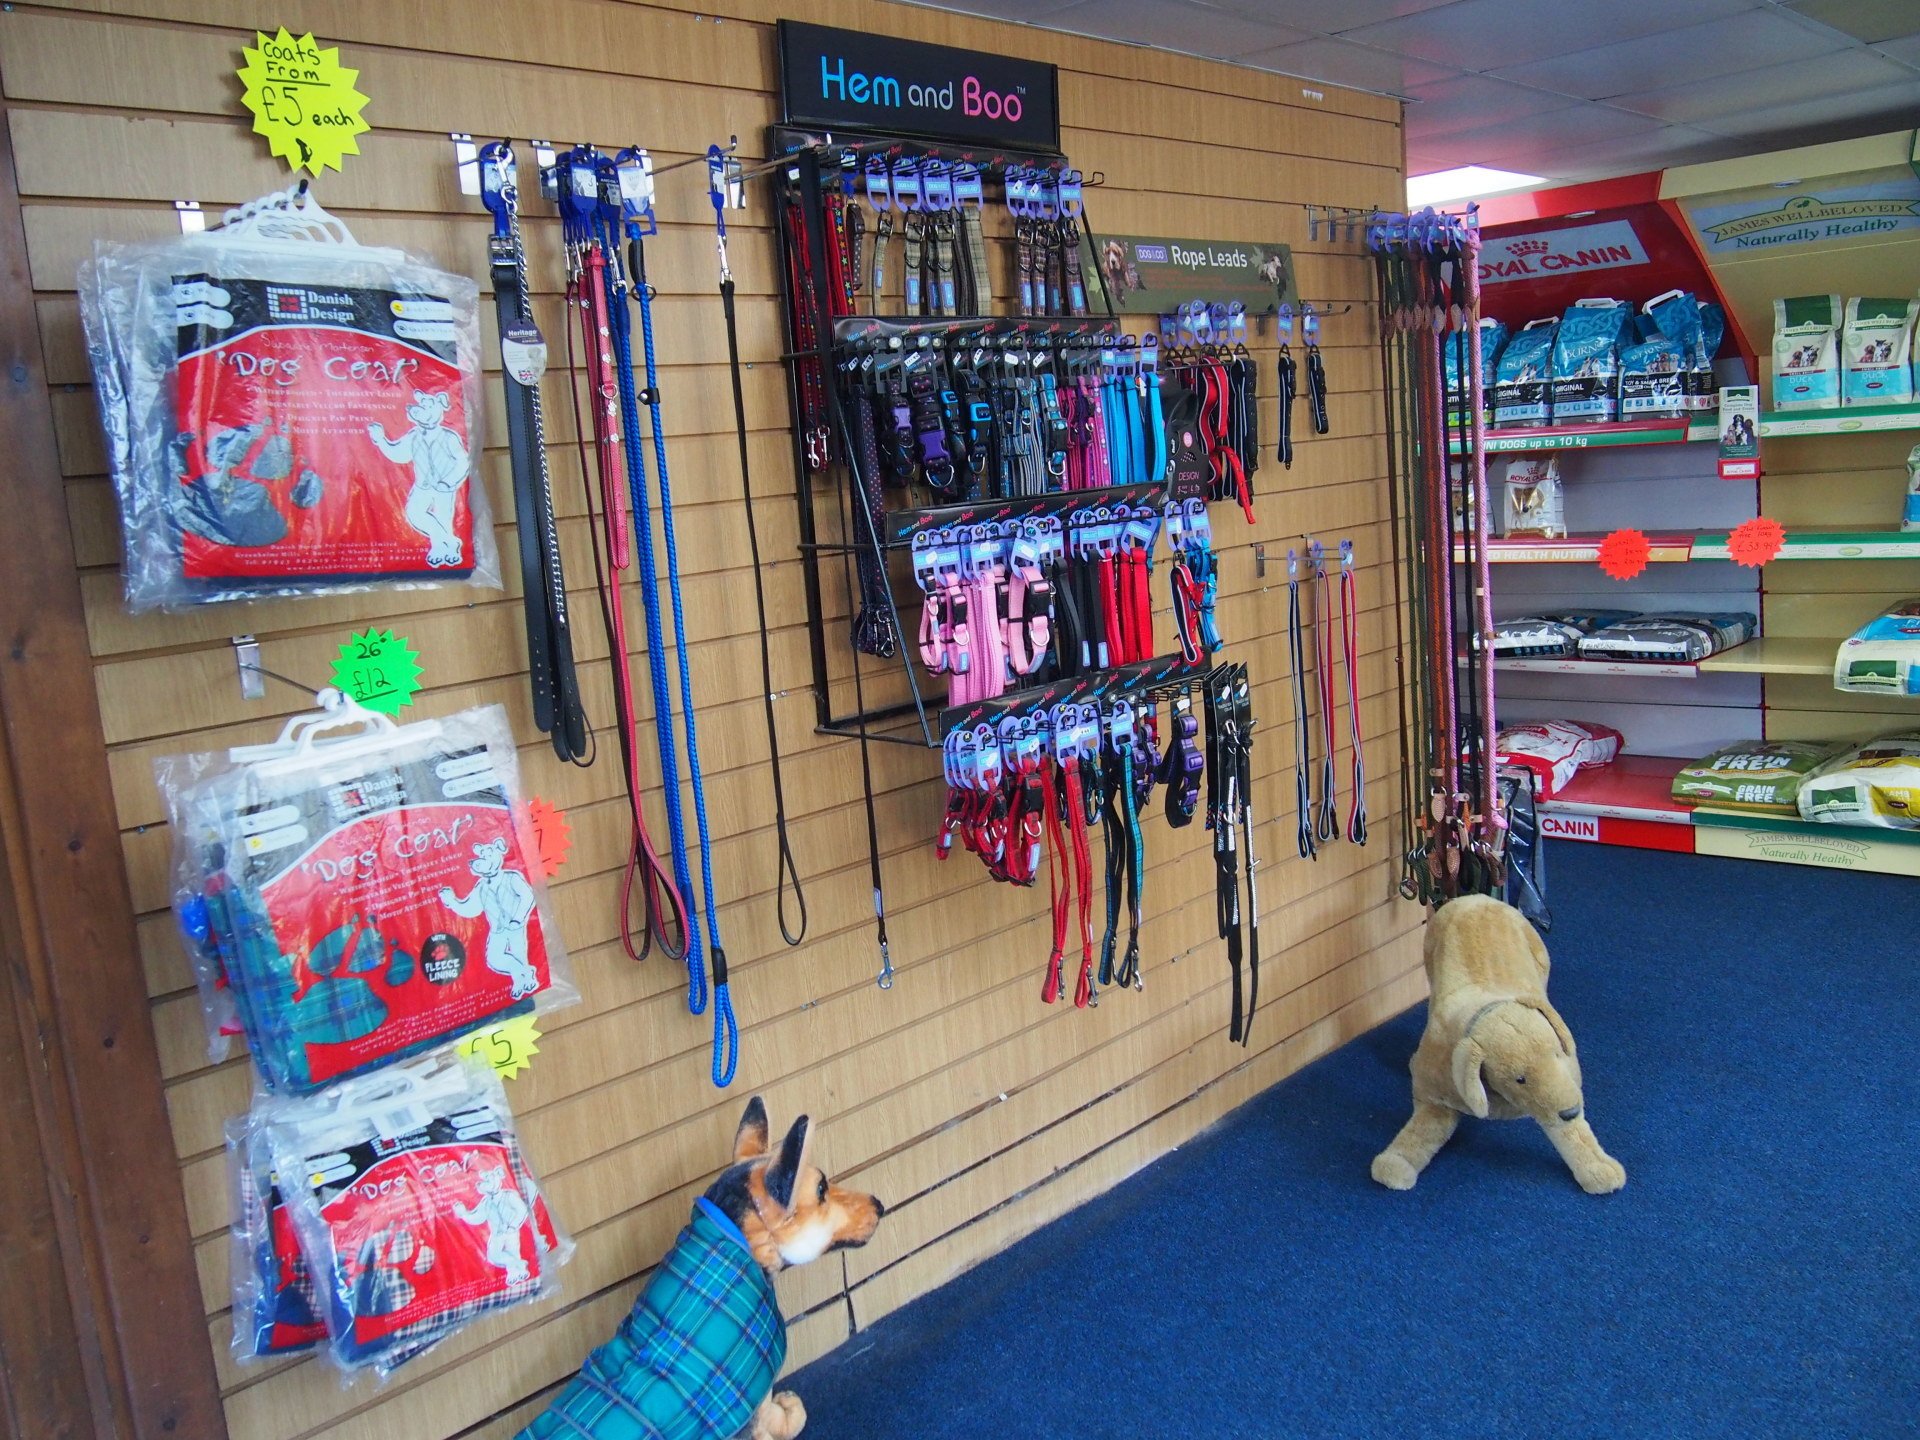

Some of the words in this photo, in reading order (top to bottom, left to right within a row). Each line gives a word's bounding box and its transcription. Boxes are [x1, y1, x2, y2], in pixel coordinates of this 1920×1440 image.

[266, 61, 319, 81] From
[821, 55, 901, 108] Hem
[907, 81, 954, 110] and
[262, 86, 303, 126] £5
[312, 107, 354, 126] each
[1721, 218, 1771, 236] JAMES
[1772, 204, 1903, 223] WELLBELOVED
[1736, 228, 1819, 248] Naturally
[1825, 218, 1899, 237] Healthy
[1171, 245, 1206, 270] Rope
[1208, 247, 1247, 267] Leads
[1478, 258, 1538, 279] OYAL
[1540, 245, 1632, 270] CANIN
[308, 291, 353, 306] Danish
[310, 306, 355, 322] Design
[508, 329, 538, 337] Heritage
[1789, 376, 1813, 384] DUCK
[1500, 439, 1527, 449] DOGS
[1530, 439, 1542, 448] up
[1545, 438, 1555, 447] to
[1559, 437, 1572, 446] 10
[1576, 436, 1588, 447] kg
[1178, 472, 1200, 481] DESIGN
[899, 527, 912, 537] Hem
[911, 521, 920, 530] and
[920, 514, 933, 524] Boo
[953, 517, 962, 526] and
[961, 511, 974, 521] Boo
[1504, 550, 1549, 560] HEALTH
[352, 667, 392, 699] £12
[1124, 678, 1136, 689] Hem
[1155, 670, 1167, 681] Hem
[1093, 686, 1106, 697] Hem
[1026, 702, 1039, 714] Hem
[1038, 696, 1046, 706] and
[1044, 690, 1055, 700] Boo
[950, 721, 964, 733] Hem
[963, 715, 972, 725] and
[971, 707, 983, 718] Boo
[989, 712, 1002, 724] Hem
[1002, 705, 1010, 715] and
[1711, 759, 1784, 771] FREE
[1718, 754, 1792, 768] GRAIN
[363, 774, 404, 793] Danish
[1738, 784, 1776, 794] GRAIN
[368, 788, 407, 806] Design
[1735, 791, 1774, 803] FREE
[1542, 818, 1595, 836] CANIN
[1755, 835, 1786, 844] JAMES
[1786, 834, 1860, 852] WELLBELOVED
[1760, 847, 1810, 862] Naturally
[1812, 852, 1855, 866] Healthy
[431, 934, 447, 942] WITH
[425, 959, 460, 973] FLEECE
[429, 970, 459, 983] LINING
